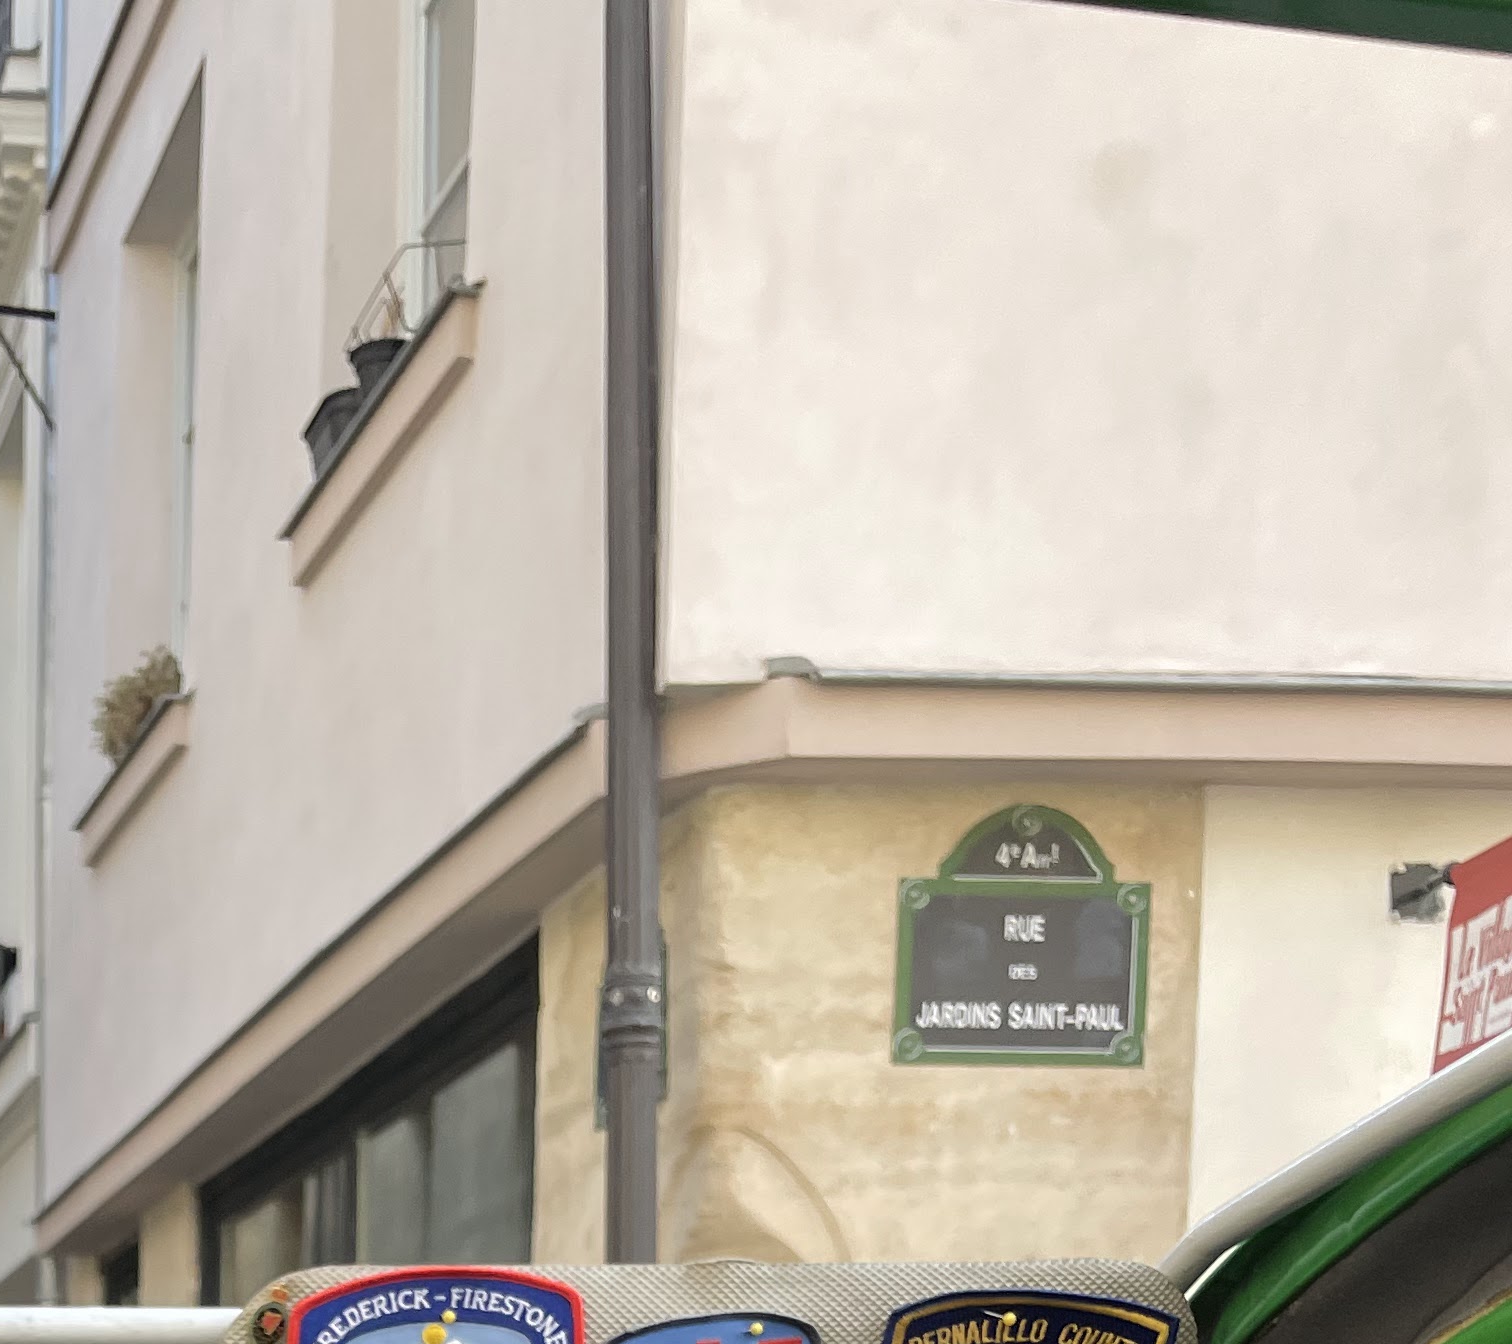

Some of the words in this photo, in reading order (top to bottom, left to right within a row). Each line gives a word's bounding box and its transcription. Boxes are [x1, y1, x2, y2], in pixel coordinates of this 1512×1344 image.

[1003, 914, 1046, 942] RUE
[1008, 963, 1038, 980] DES
[915, 1001, 1002, 1030] JARDINS
[1007, 1001, 1124, 1031] SAINT-PAUL
